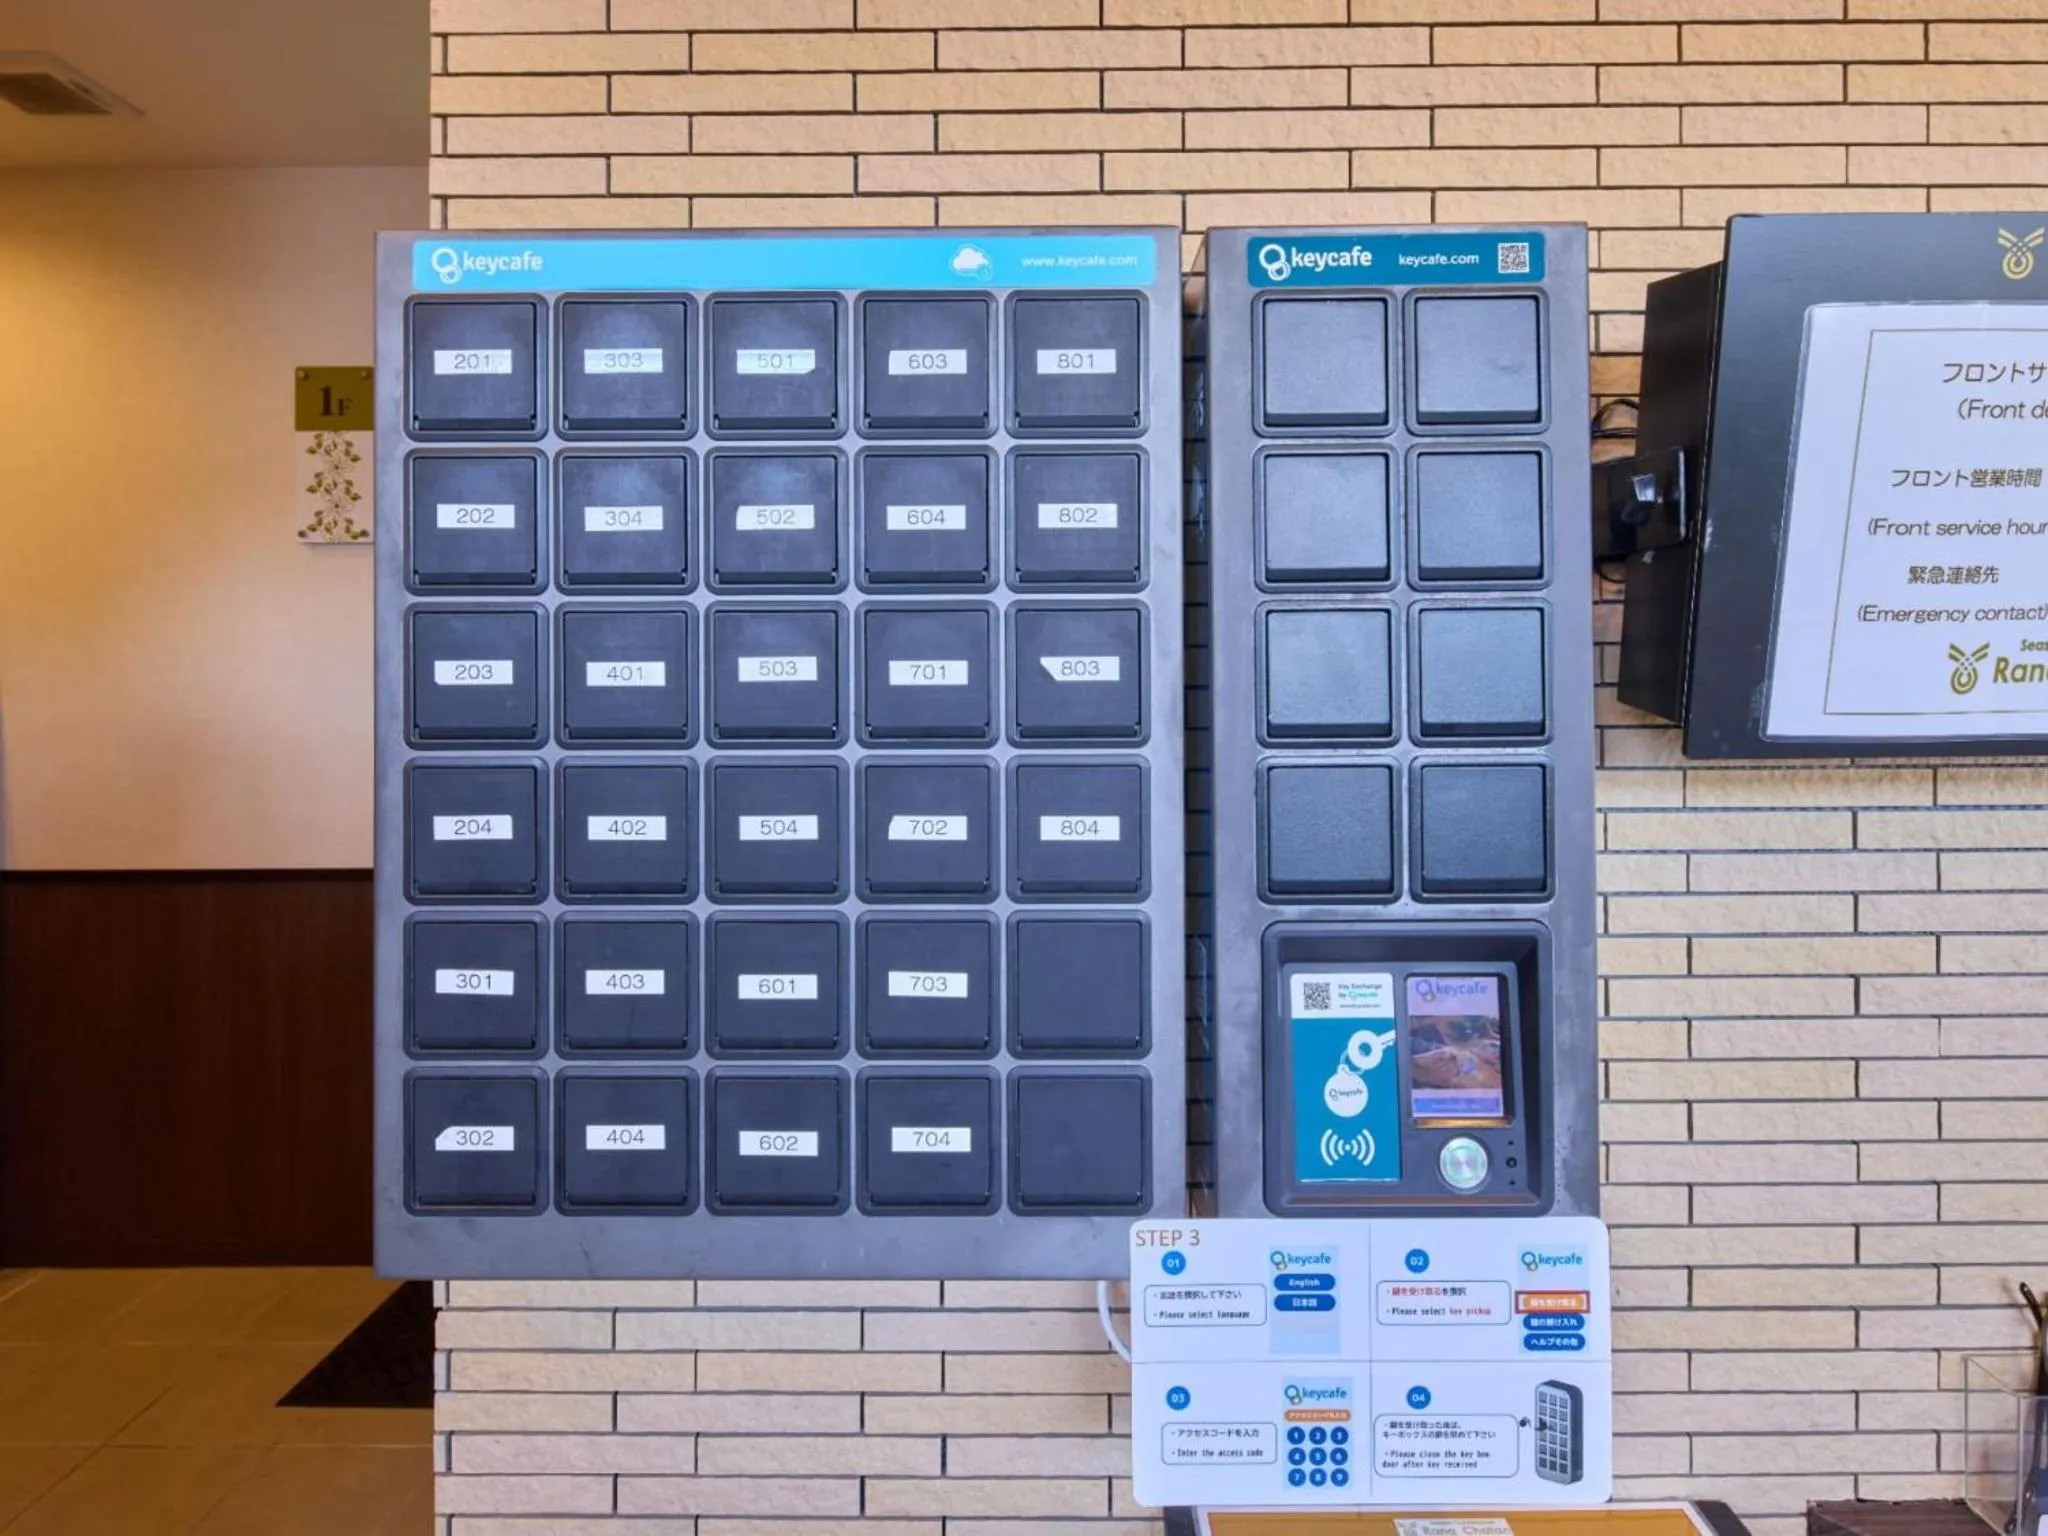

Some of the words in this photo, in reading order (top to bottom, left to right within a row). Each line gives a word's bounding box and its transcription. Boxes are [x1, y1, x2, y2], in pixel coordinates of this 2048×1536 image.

[463, 250, 543, 275] keycafe
[1021, 255, 1137, 269] www.keycafe.com
[1291, 246, 1372, 272] keycafe
[1399, 253, 1480, 267] keycafe.com
[453, 353, 490, 369] 201
[604, 352, 645, 368] 303
[756, 353, 794, 368] 501
[908, 353, 948, 369] 603
[1056, 353, 1094, 368] 801
[1942, 362, 2048, 384] フロントサ
[320, 385, 353, 417] 1F
[1958, 398, 2026, 421] (Front
[1891, 468, 2043, 488] フロント営業時間
[456, 508, 496, 523] 202
[604, 510, 643, 526] 304
[756, 509, 796, 525] 502
[907, 509, 946, 525] 604
[1058, 508, 1099, 523] 802
[1868, 518, 1930, 536] (Front
[1936, 519, 2002, 536] service
[1907, 565, 2000, 584] 緊急連絡先
[1857, 604, 1970, 623] (Emergency
[454, 664, 494, 680] 203
[605, 666, 643, 681] 401
[759, 660, 798, 676] 503
[909, 664, 946, 680] 701
[1060, 660, 1101, 676] 803
[1993, 656, 2048, 684] Ran
[453, 819, 493, 835] 204
[607, 820, 647, 835] 402
[760, 820, 799, 835] 504
[908, 820, 948, 835] 702
[1060, 820, 1100, 836] 804
[455, 974, 492, 989] 301
[605, 974, 646, 989] 403
[758, 979, 795, 994] 601
[909, 976, 948, 992] 703
[1436, 982, 1488, 997] keycafe
[455, 1130, 495, 1146] 302
[606, 1129, 646, 1144] 404
[758, 1135, 799, 1151] 602
[912, 1131, 951, 1147] 704
[1135, 1229, 1183, 1247] STEP
[1189, 1229, 1201, 1247] 3
[1167, 1259, 1180, 1268] 01
[1287, 1253, 1332, 1267] keycafe
[1410, 1257, 1424, 1266] 02
[1538, 1253, 1583, 1267] keycafe
[1288, 1278, 1321, 1288] English
[1392, 1306, 1417, 1315] Please
[1421, 1306, 1446, 1315] select
[1171, 1394, 1185, 1403] 03
[1302, 1386, 1347, 1401] keycafe
[1412, 1393, 1425, 1402] 04
[1177, 1428, 1260, 1438] アクセスコードを入力
